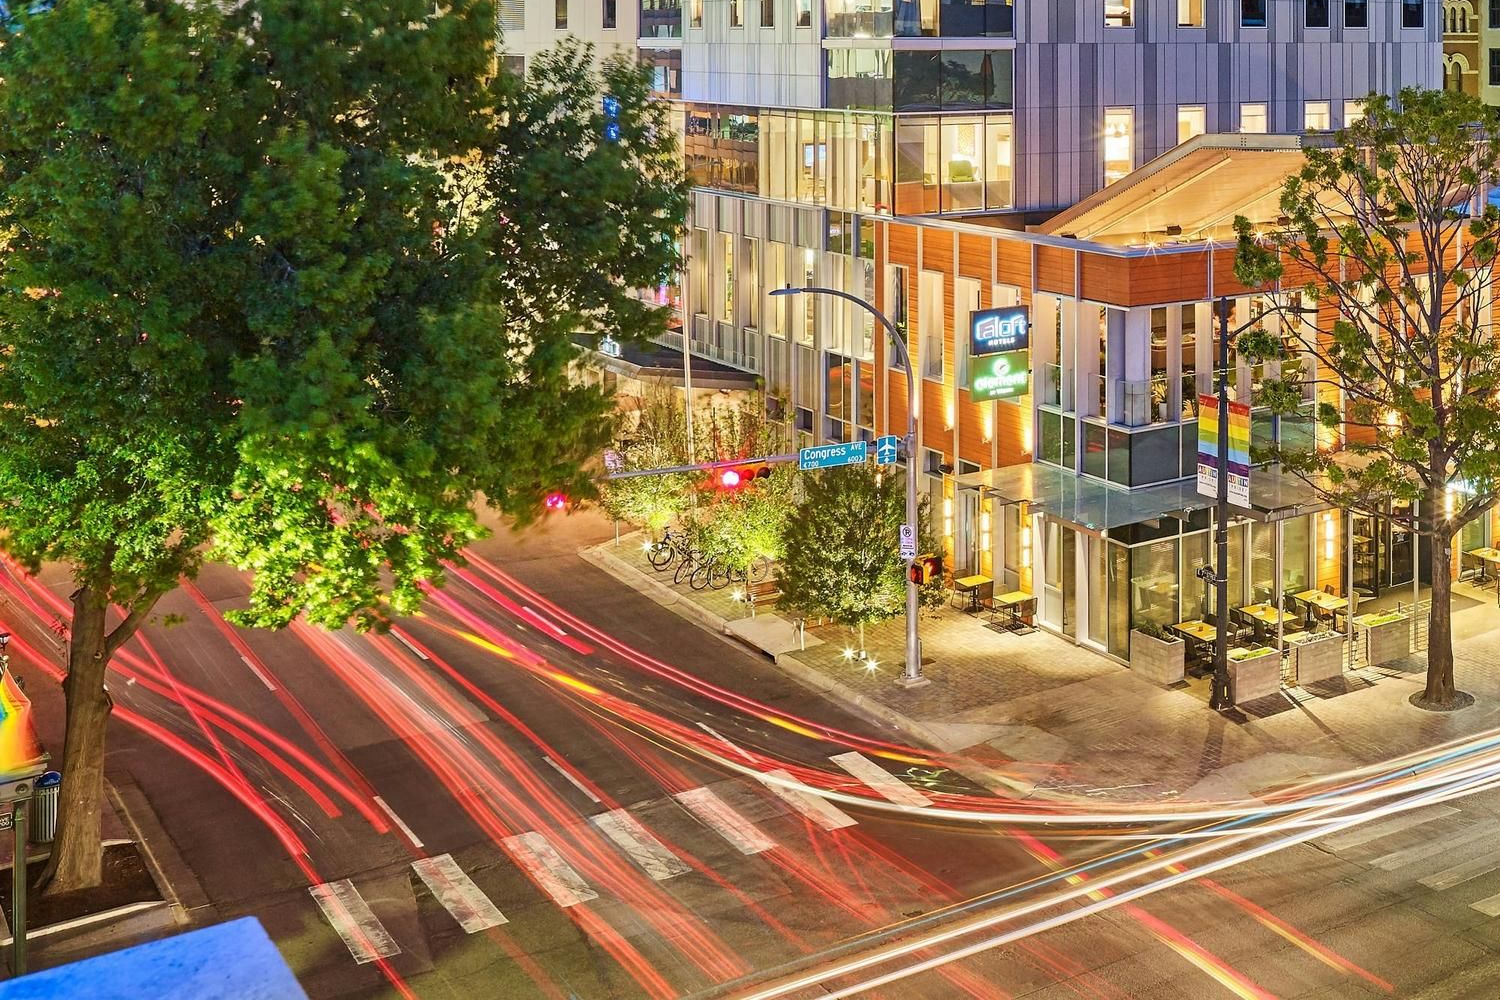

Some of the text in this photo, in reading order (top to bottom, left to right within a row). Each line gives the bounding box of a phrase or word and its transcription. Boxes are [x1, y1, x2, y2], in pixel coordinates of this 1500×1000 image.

[976, 314, 1027, 340] aloft
[988, 337, 1015, 346] HOTELS
[804, 443, 863, 460] Congress AVE
[847, 455, 859, 463] 600
